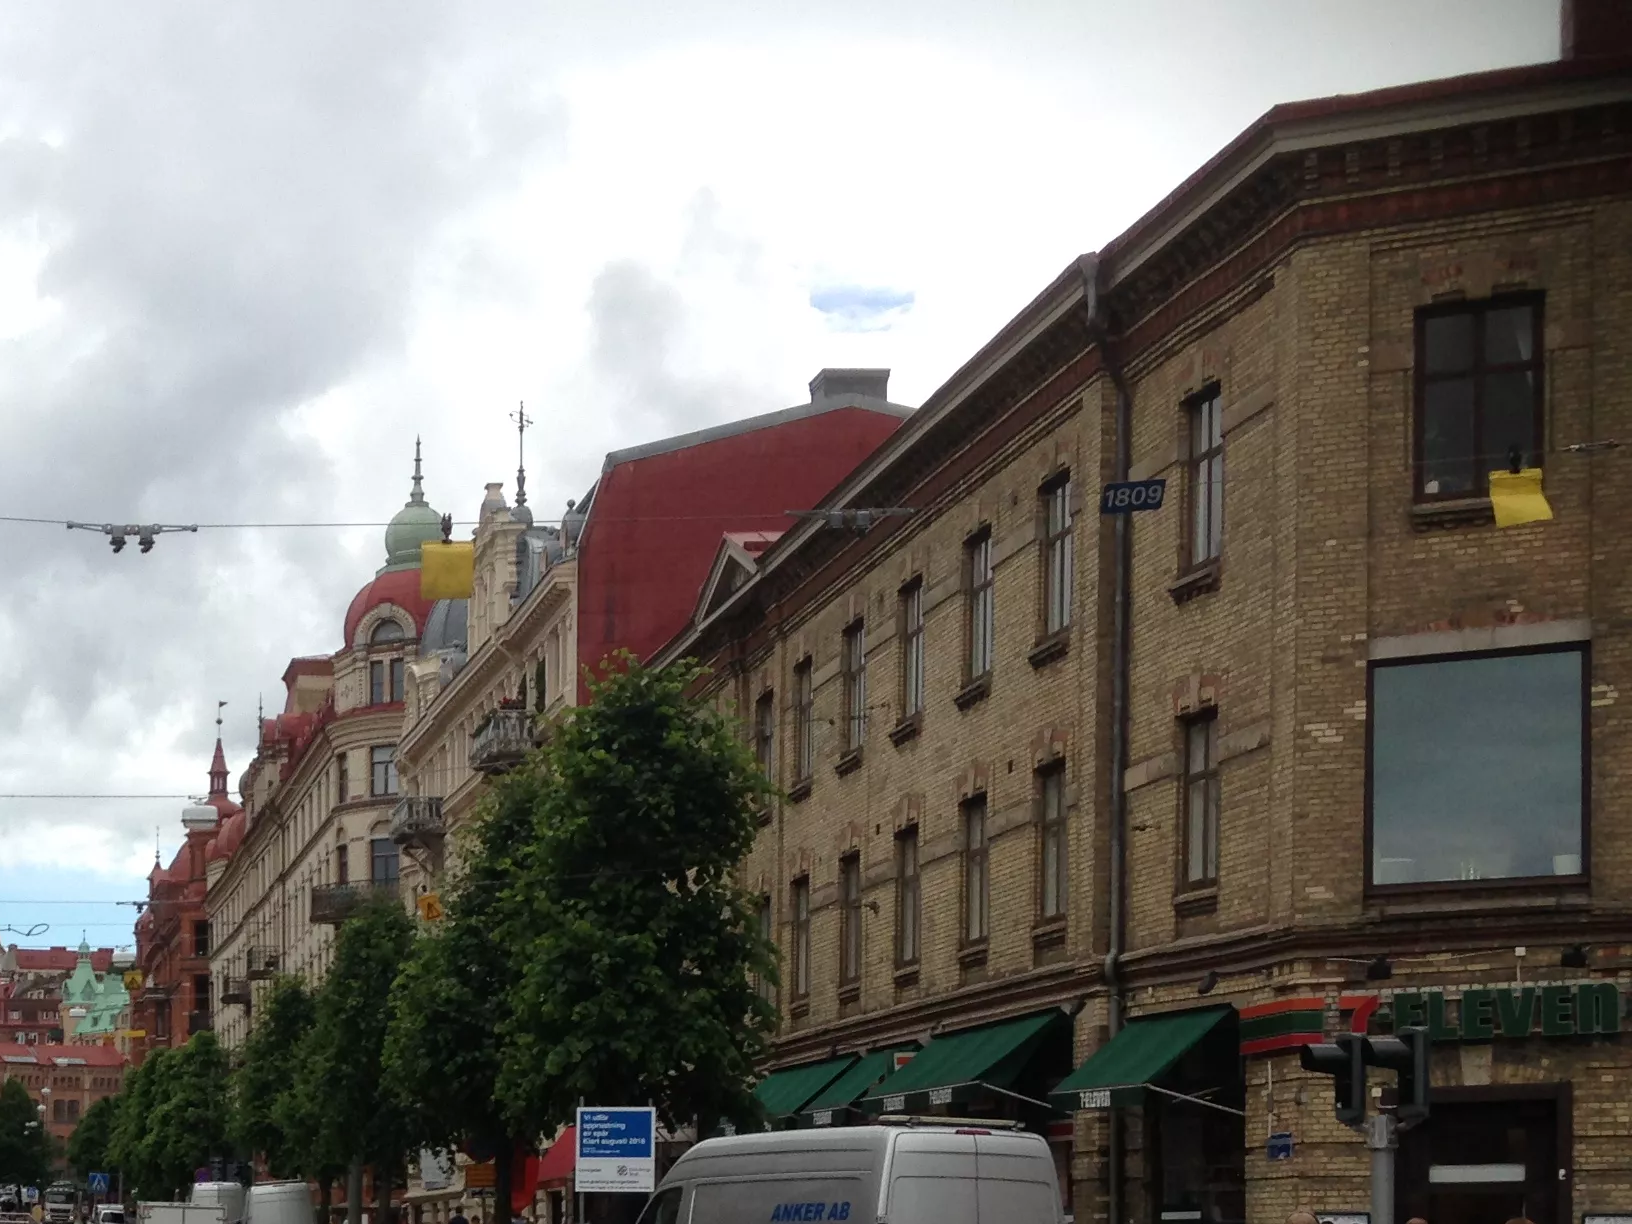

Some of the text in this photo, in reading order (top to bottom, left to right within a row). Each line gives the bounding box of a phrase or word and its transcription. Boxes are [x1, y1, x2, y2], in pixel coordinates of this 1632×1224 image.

[1105, 484, 1163, 508] 1809
[769, 1200, 852, 1222] ANKER AB
